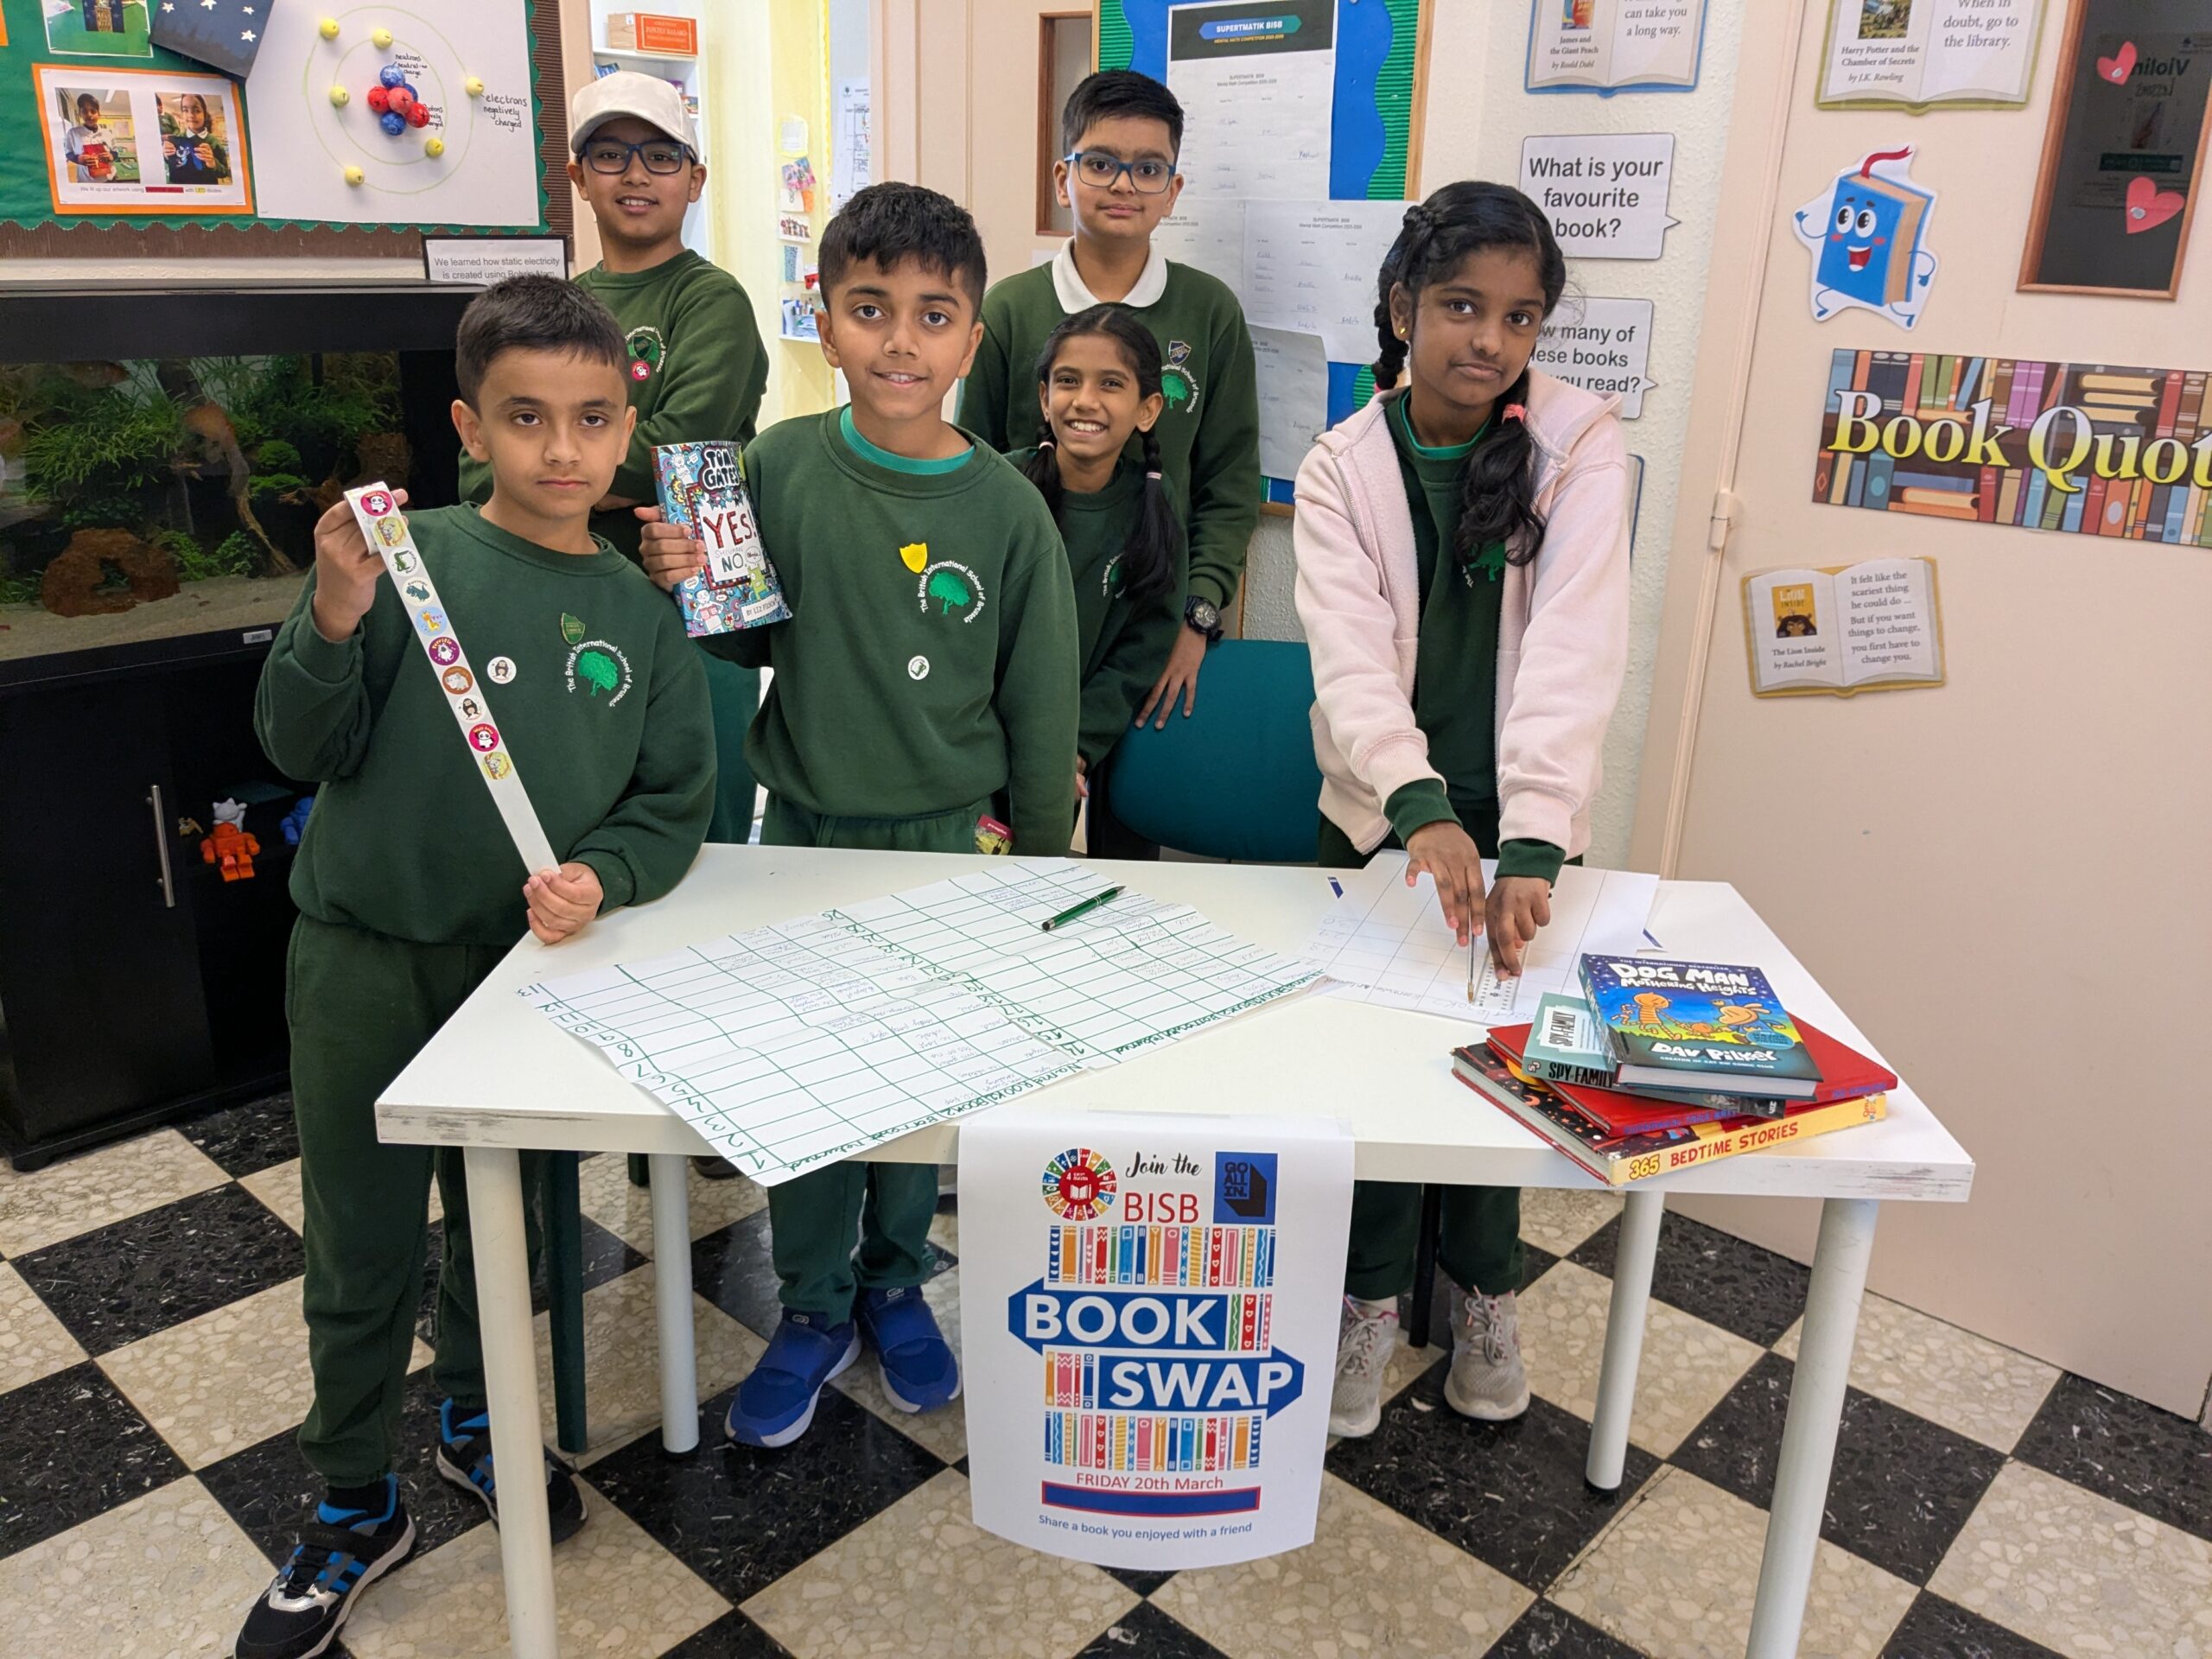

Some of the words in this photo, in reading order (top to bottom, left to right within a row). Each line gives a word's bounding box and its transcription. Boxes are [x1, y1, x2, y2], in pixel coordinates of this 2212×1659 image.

[1625, 10, 1642, 19] can
[1645, 7, 1666, 17] take
[1669, 9, 1687, 20] you
[1217, 22, 1265, 33] SUPERTMATIK
[1266, 21, 1282, 29] BISB
[1943, 16, 1983, 29] doubt,
[1986, 17, 2002, 30] go
[2005, 16, 2018, 27] to
[1627, 28, 1632, 36] a
[1635, 25, 1656, 38] long
[1659, 27, 1681, 38] way.
[1560, 36, 1579, 45] James
[1944, 35, 1963, 48] the
[1967, 34, 2012, 50] library.
[1580, 46, 1599, 54] Peach
[1841, 47, 1865, 56] Harry
[1866, 46, 1889, 54] Potter
[1907, 45, 1920, 54] the
[1841, 58, 1877, 67] Chamber
[1888, 57, 1916, 66] Secrets
[1848, 73, 1857, 83] by
[1858, 73, 1872, 82] J.K.
[1873, 73, 1904, 83] Rowling
[486, 94, 528, 107] electrons
[484, 106, 520, 121] negatively
[1529, 157, 1582, 178] What
[1588, 157, 1605, 177] is
[1611, 159, 1663, 181] your
[1543, 188, 1639, 208] favourite
[1554, 218, 1621, 238] book?
[451, 257, 481, 266] learned
[483, 257, 499, 266] how
[502, 257, 523, 266] static
[524, 257, 560, 267] electricity
[452, 270, 482, 279] created
[1561, 327, 1611, 346] many
[1616, 326, 1636, 343] of
[1573, 348, 1628, 367] books
[1586, 376, 1641, 394] read?
[1827, 389, 2014, 467] Book
[705, 448, 734, 468] TOM
[703, 467, 740, 490] GATES
[702, 510, 757, 549] YES!
[925, 560, 968, 576] International
[918, 574, 928, 598] British
[967, 570, 984, 591] School
[1851, 576, 1858, 585] It
[1859, 575, 1873, 584] felt
[1875, 573, 1891, 582] like
[1892, 572, 1907, 581] the
[978, 592, 986, 601] of
[1852, 588, 1883, 597] scariest
[1885, 584, 1909, 595] thing
[919, 599, 929, 613] The
[1851, 601, 1861, 609] he
[1863, 598, 1888, 608] could
[1890, 597, 1901, 606] do
[963, 601, 985, 623] Brussels
[1850, 616, 1866, 625] But
[1867, 614, 1874, 623] if
[1875, 614, 1891, 624] you
[1894, 612, 1916, 620] want
[1847, 627, 1874, 638] things
[572, 639, 618, 654] International
[1803, 646, 1826, 655] Inside
[1852, 644, 1867, 653] you
[1869, 642, 1886, 651] first
[1888, 640, 1909, 649] have
[564, 652, 577, 676] British
[616, 651, 632, 673] School
[1783, 659, 1805, 669] Rachel
[1806, 658, 1827, 669] Bright
[1861, 654, 1891, 664] change
[1893, 653, 1911, 663] you.
[567, 677, 576, 693] The
[625, 674, 632, 683] of
[1608, 963, 1680, 982] DOG
[1686, 969, 1750, 987] MAN
[617, 1043, 633, 1058] 8
[1651, 1042, 1700, 1057] DAV
[637, 1064, 651, 1077] 7
[1548, 1062, 1572, 1081] SPY
[671, 1084, 689, 1095] 5
[704, 1116, 725, 1131] 3
[725, 1134, 744, 1147] 2
[1126, 1151, 1167, 1179] Join
[1172, 1152, 1202, 1177] the
[1224, 1161, 1249, 1173] GO
[1629, 1154, 1661, 1180] 365
[1224, 1173, 1247, 1186] ALL
[1224, 1185, 1248, 1197] IN.
[1124, 1192, 1199, 1224] BISB
[1026, 1295, 1219, 1345] BOOK
[1109, 1361, 1294, 1409] SWAP
[1077, 1472, 1130, 1489] FRIDAY
[1135, 1476, 1169, 1490] 20th
[1175, 1476, 1224, 1491] March
[1039, 1514, 1069, 1529] Share
[1081, 1522, 1109, 1536] book
[1111, 1528, 1133, 1540] you
[1135, 1528, 1179, 1541] enjoyed
[1182, 1528, 1207, 1538] with
[1210, 1529, 1217, 1537] a
[1220, 1522, 1253, 1535] friend
